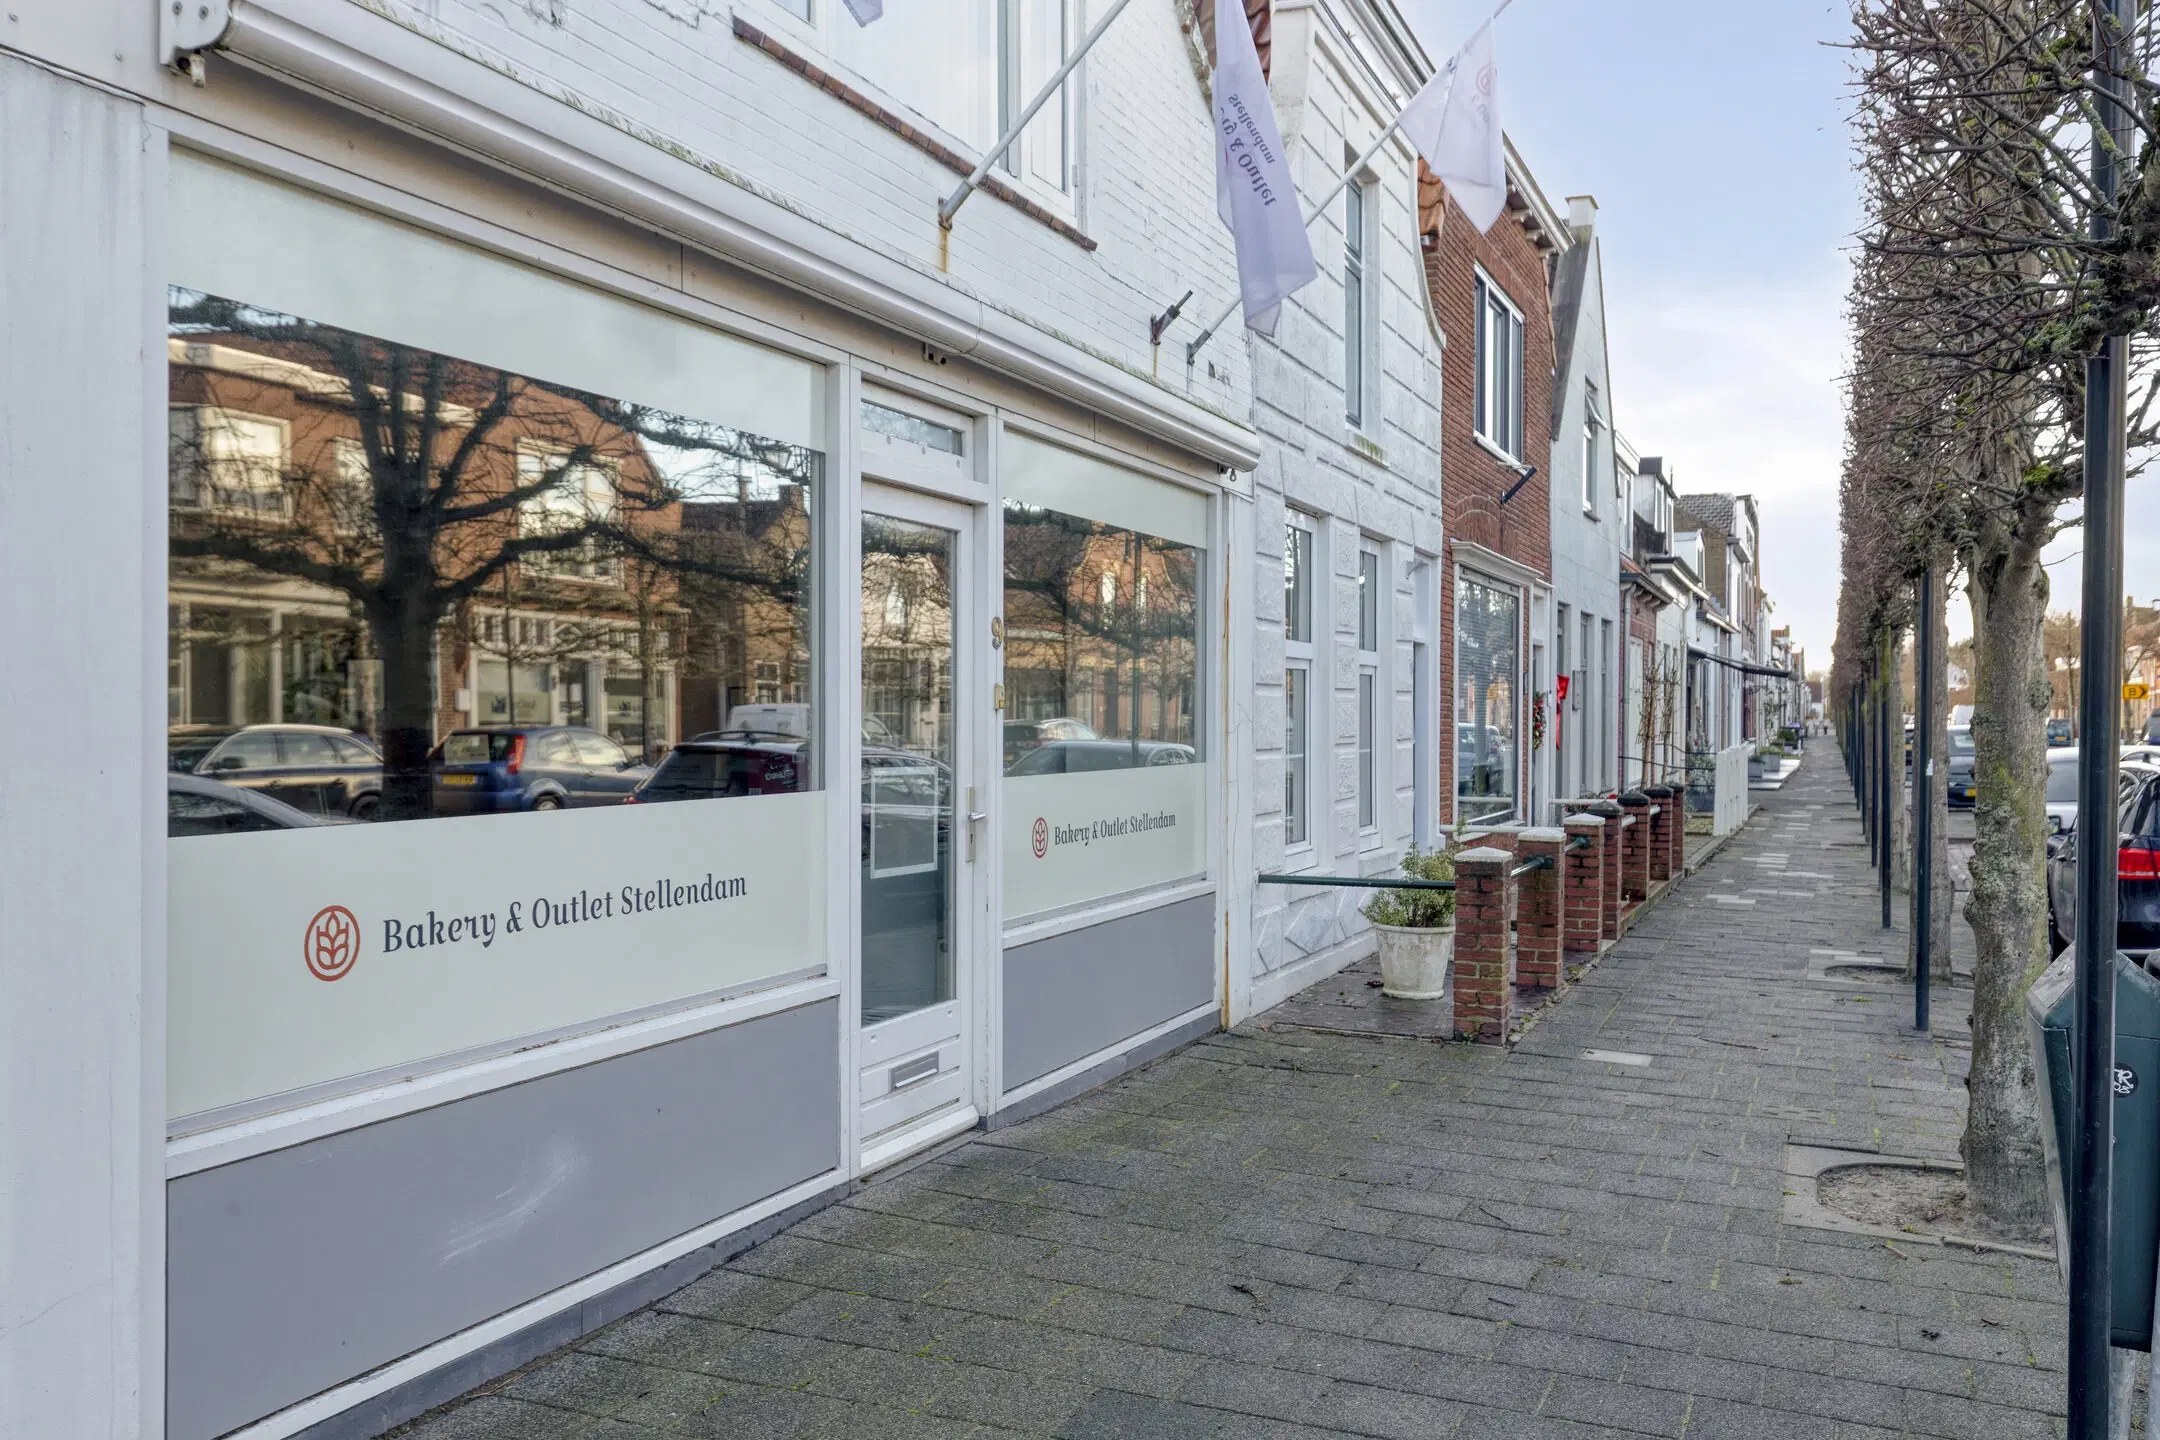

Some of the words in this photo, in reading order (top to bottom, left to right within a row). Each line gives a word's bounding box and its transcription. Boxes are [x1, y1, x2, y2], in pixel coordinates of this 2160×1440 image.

[991, 616, 1003, 650] 9
[1054, 823, 1090, 846] Bakery
[1092, 821, 1098, 839] &
[1100, 817, 1128, 838] Outlet
[1129, 811, 1176, 833] Stellendam
[382, 911, 497, 952] Bakery
[505, 901, 522, 934] &
[530, 890, 614, 929] Outlet
[620, 873, 747, 914] Stellendam
